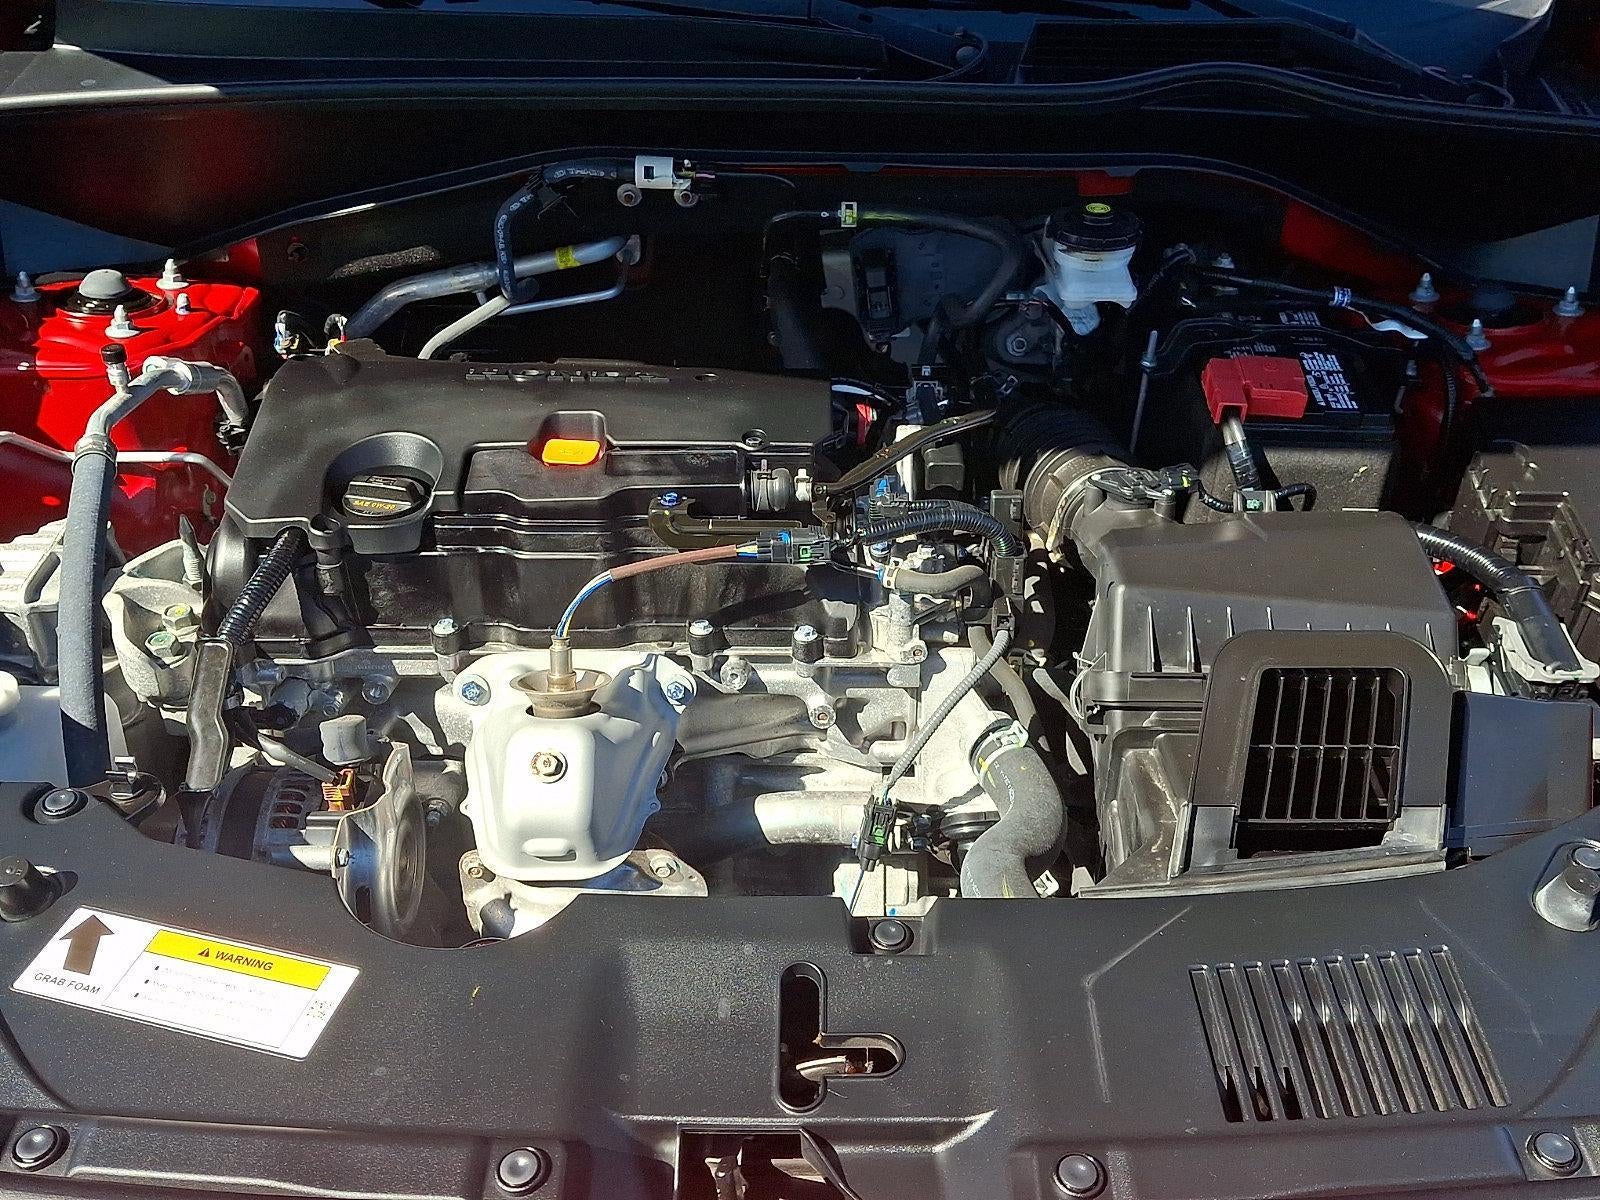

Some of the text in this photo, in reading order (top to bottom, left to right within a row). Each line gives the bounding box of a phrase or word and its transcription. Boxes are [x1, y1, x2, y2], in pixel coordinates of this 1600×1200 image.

[215, 950, 274, 972] WARNING
[34, 972, 101, 995] GRAB FOAM
